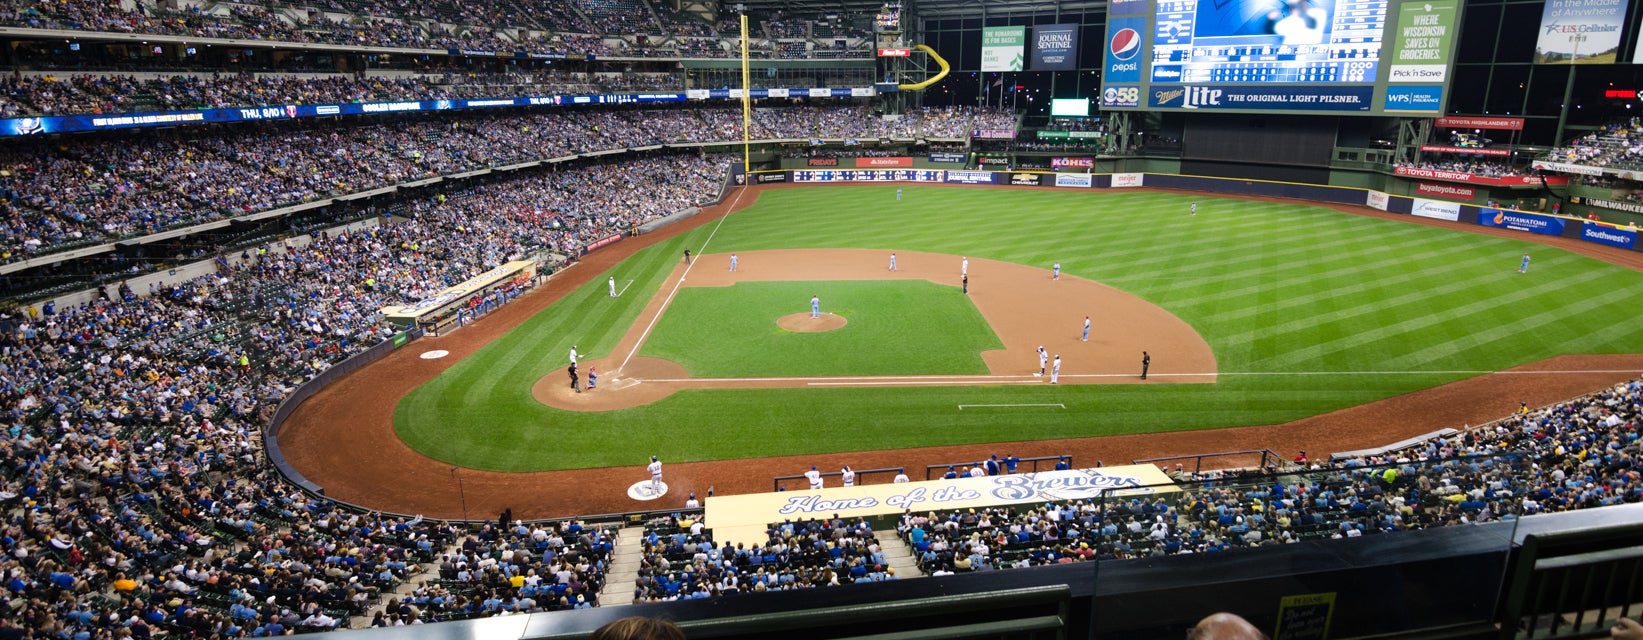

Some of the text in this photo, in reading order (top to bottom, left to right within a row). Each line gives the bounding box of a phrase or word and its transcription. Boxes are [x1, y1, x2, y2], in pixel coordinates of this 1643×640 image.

[1552, 8, 1617, 17] of Anywhere
[1414, 14, 1440, 25] WHERE
[1404, 26, 1446, 37] WISCONSIN
[1579, 24, 1618, 32] Cellular
[1040, 34, 1072, 42] JOURNAL
[1405, 38, 1440, 48] SAVES ON
[1038, 41, 1072, 49] SENTINEL
[1400, 49, 1440, 59] GROCERIES.
[1112, 62, 1137, 72] pepsi
[1117, 88, 1139, 102] 58
[1155, 90, 1184, 104] Miller
[1181, 86, 1222, 108] Lite
[1320, 95, 1361, 103] PILSNER.
[241, 108, 262, 118] THU,
[263, 107, 279, 118] 8/10
[1408, 169, 1470, 180] TOYOTA TERRITORY
[1420, 184, 1472, 196] buyatoyota.com
[1504, 216, 1547, 226] POTAWATOMI
[1585, 229, 1624, 243] Southwest
[779, 473, 1143, 515] Home of the Brewers
